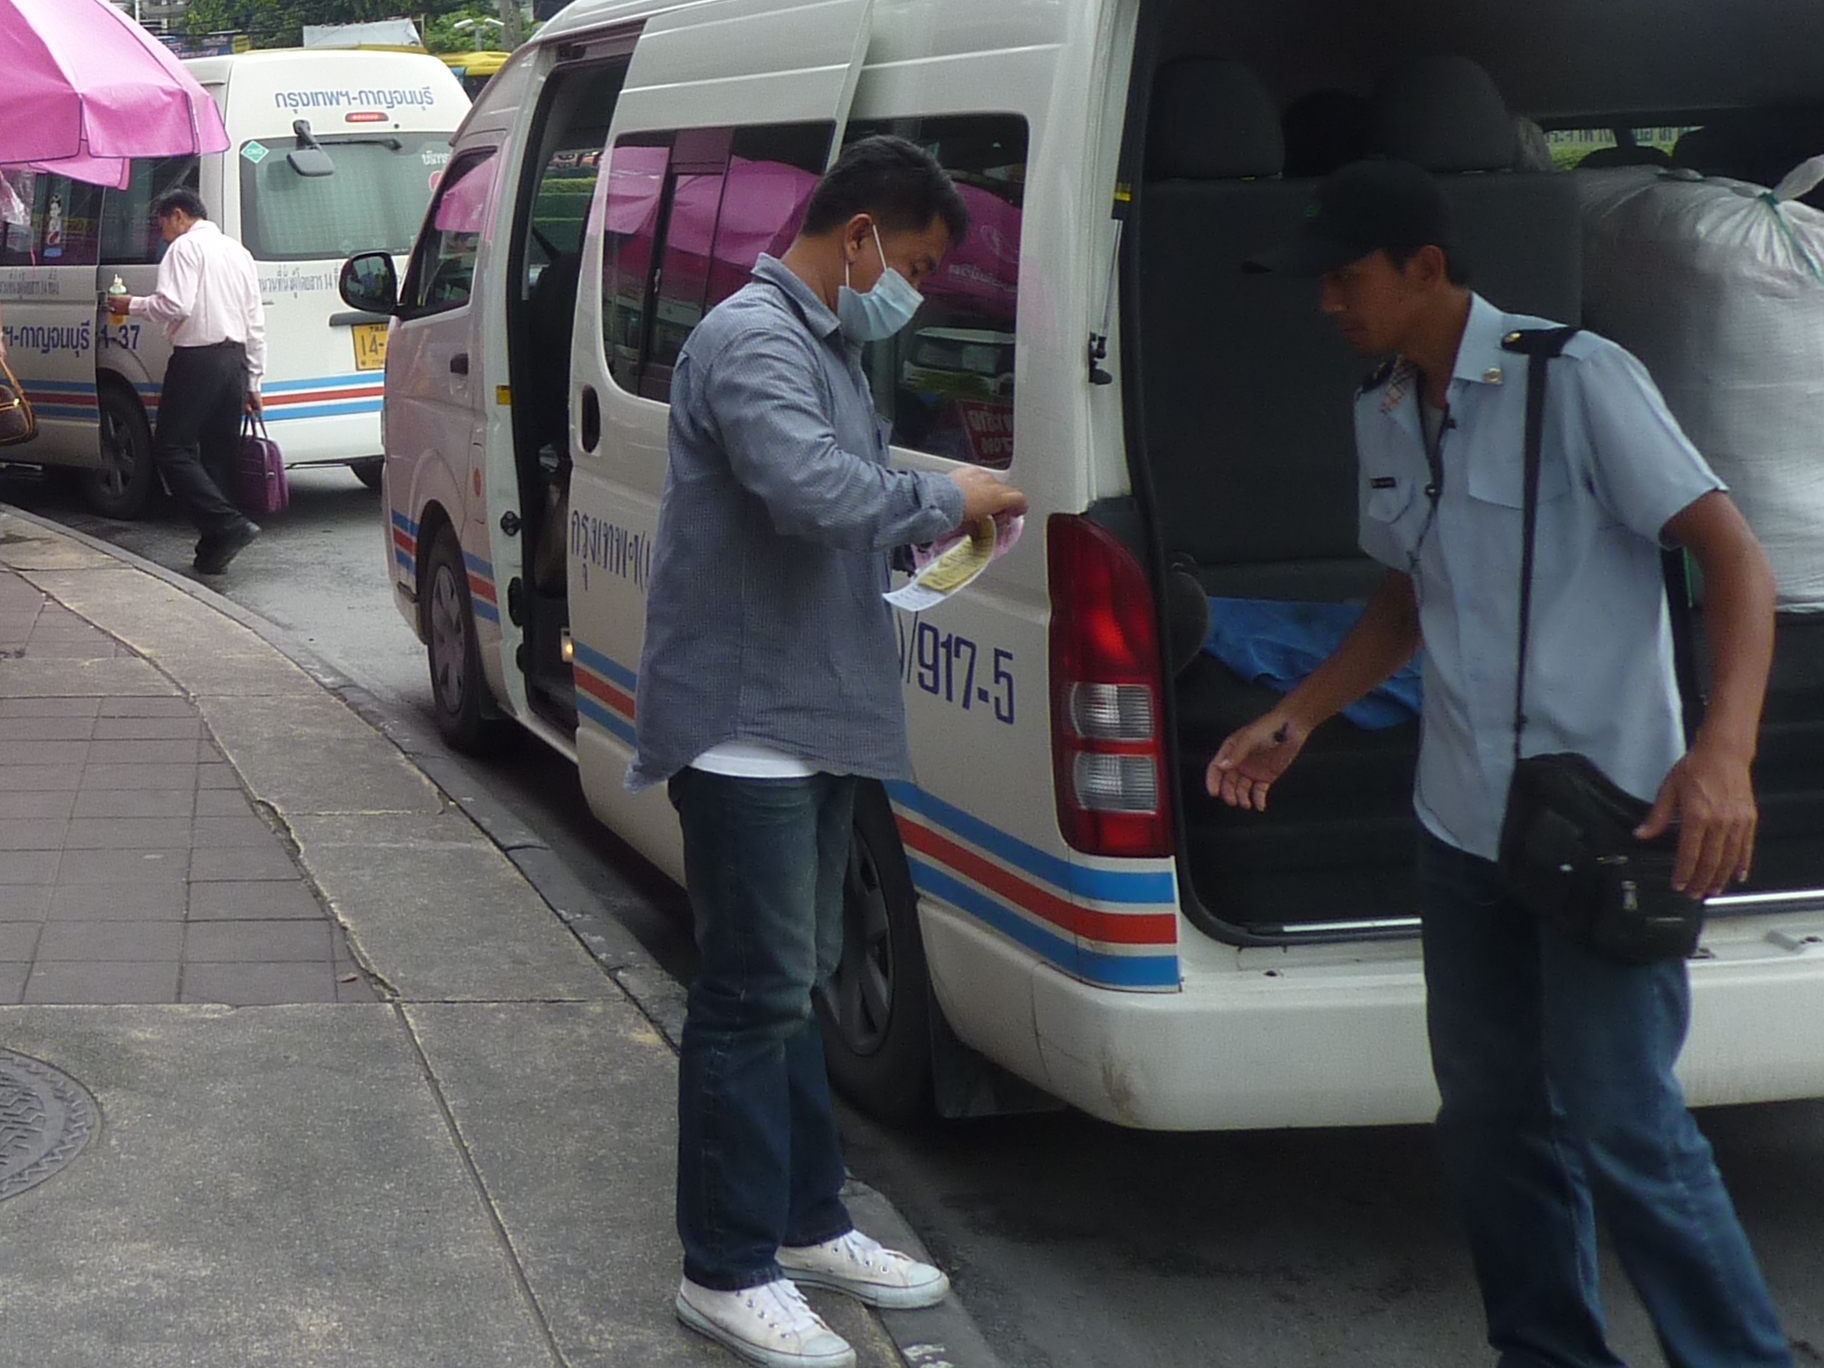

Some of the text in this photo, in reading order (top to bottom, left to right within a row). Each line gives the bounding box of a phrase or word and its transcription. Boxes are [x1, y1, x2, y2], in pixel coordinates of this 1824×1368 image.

[274, 86, 434, 114] กรุงเทพฯ-กาญจนบุรี
